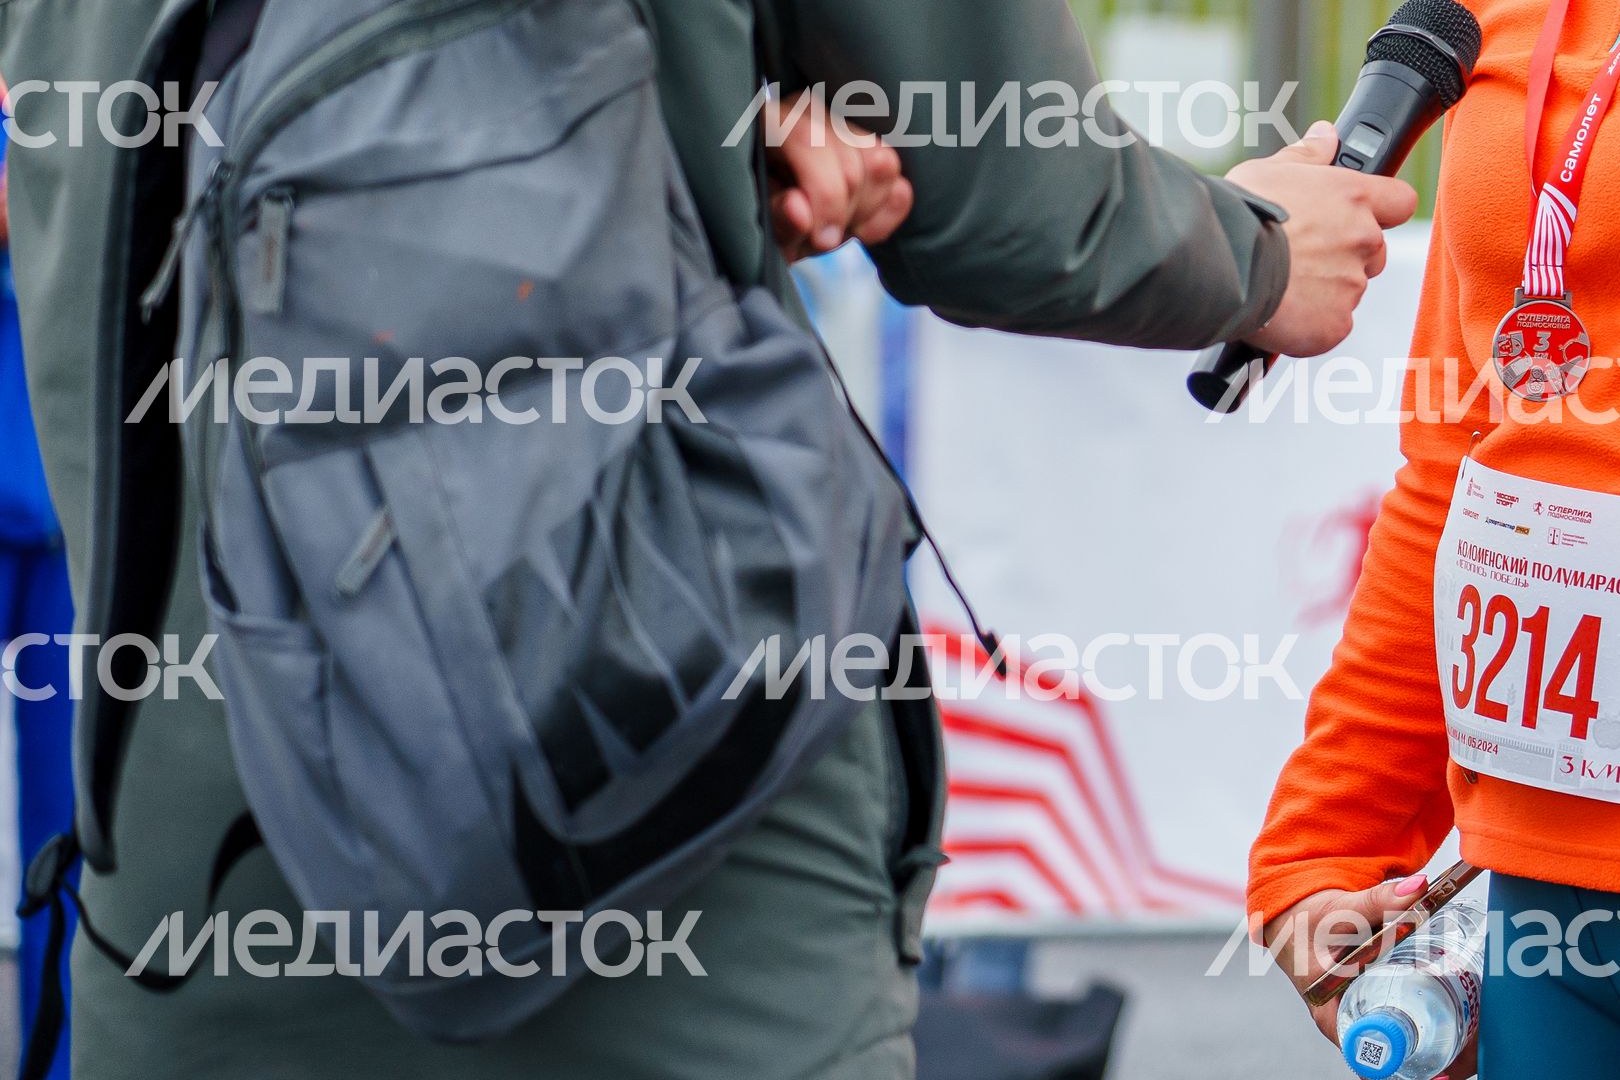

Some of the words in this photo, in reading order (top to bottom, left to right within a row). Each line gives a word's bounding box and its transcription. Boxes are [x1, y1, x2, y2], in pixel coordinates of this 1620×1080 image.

[1560, 93, 1602, 183] самолет
[1517, 313, 1571, 323] СУПЕРЛИГА
[1533, 331, 1552, 352] 3
[1547, 511, 1592, 525] ПОДМОСКОВЬЯ
[1548, 504, 1593, 519] СУПЕРЛИГА
[1457, 539, 1529, 576] КОЛОМЕНСКИЙ
[1452, 584, 1602, 740] 3214
[1559, 755, 1574, 774] 3
